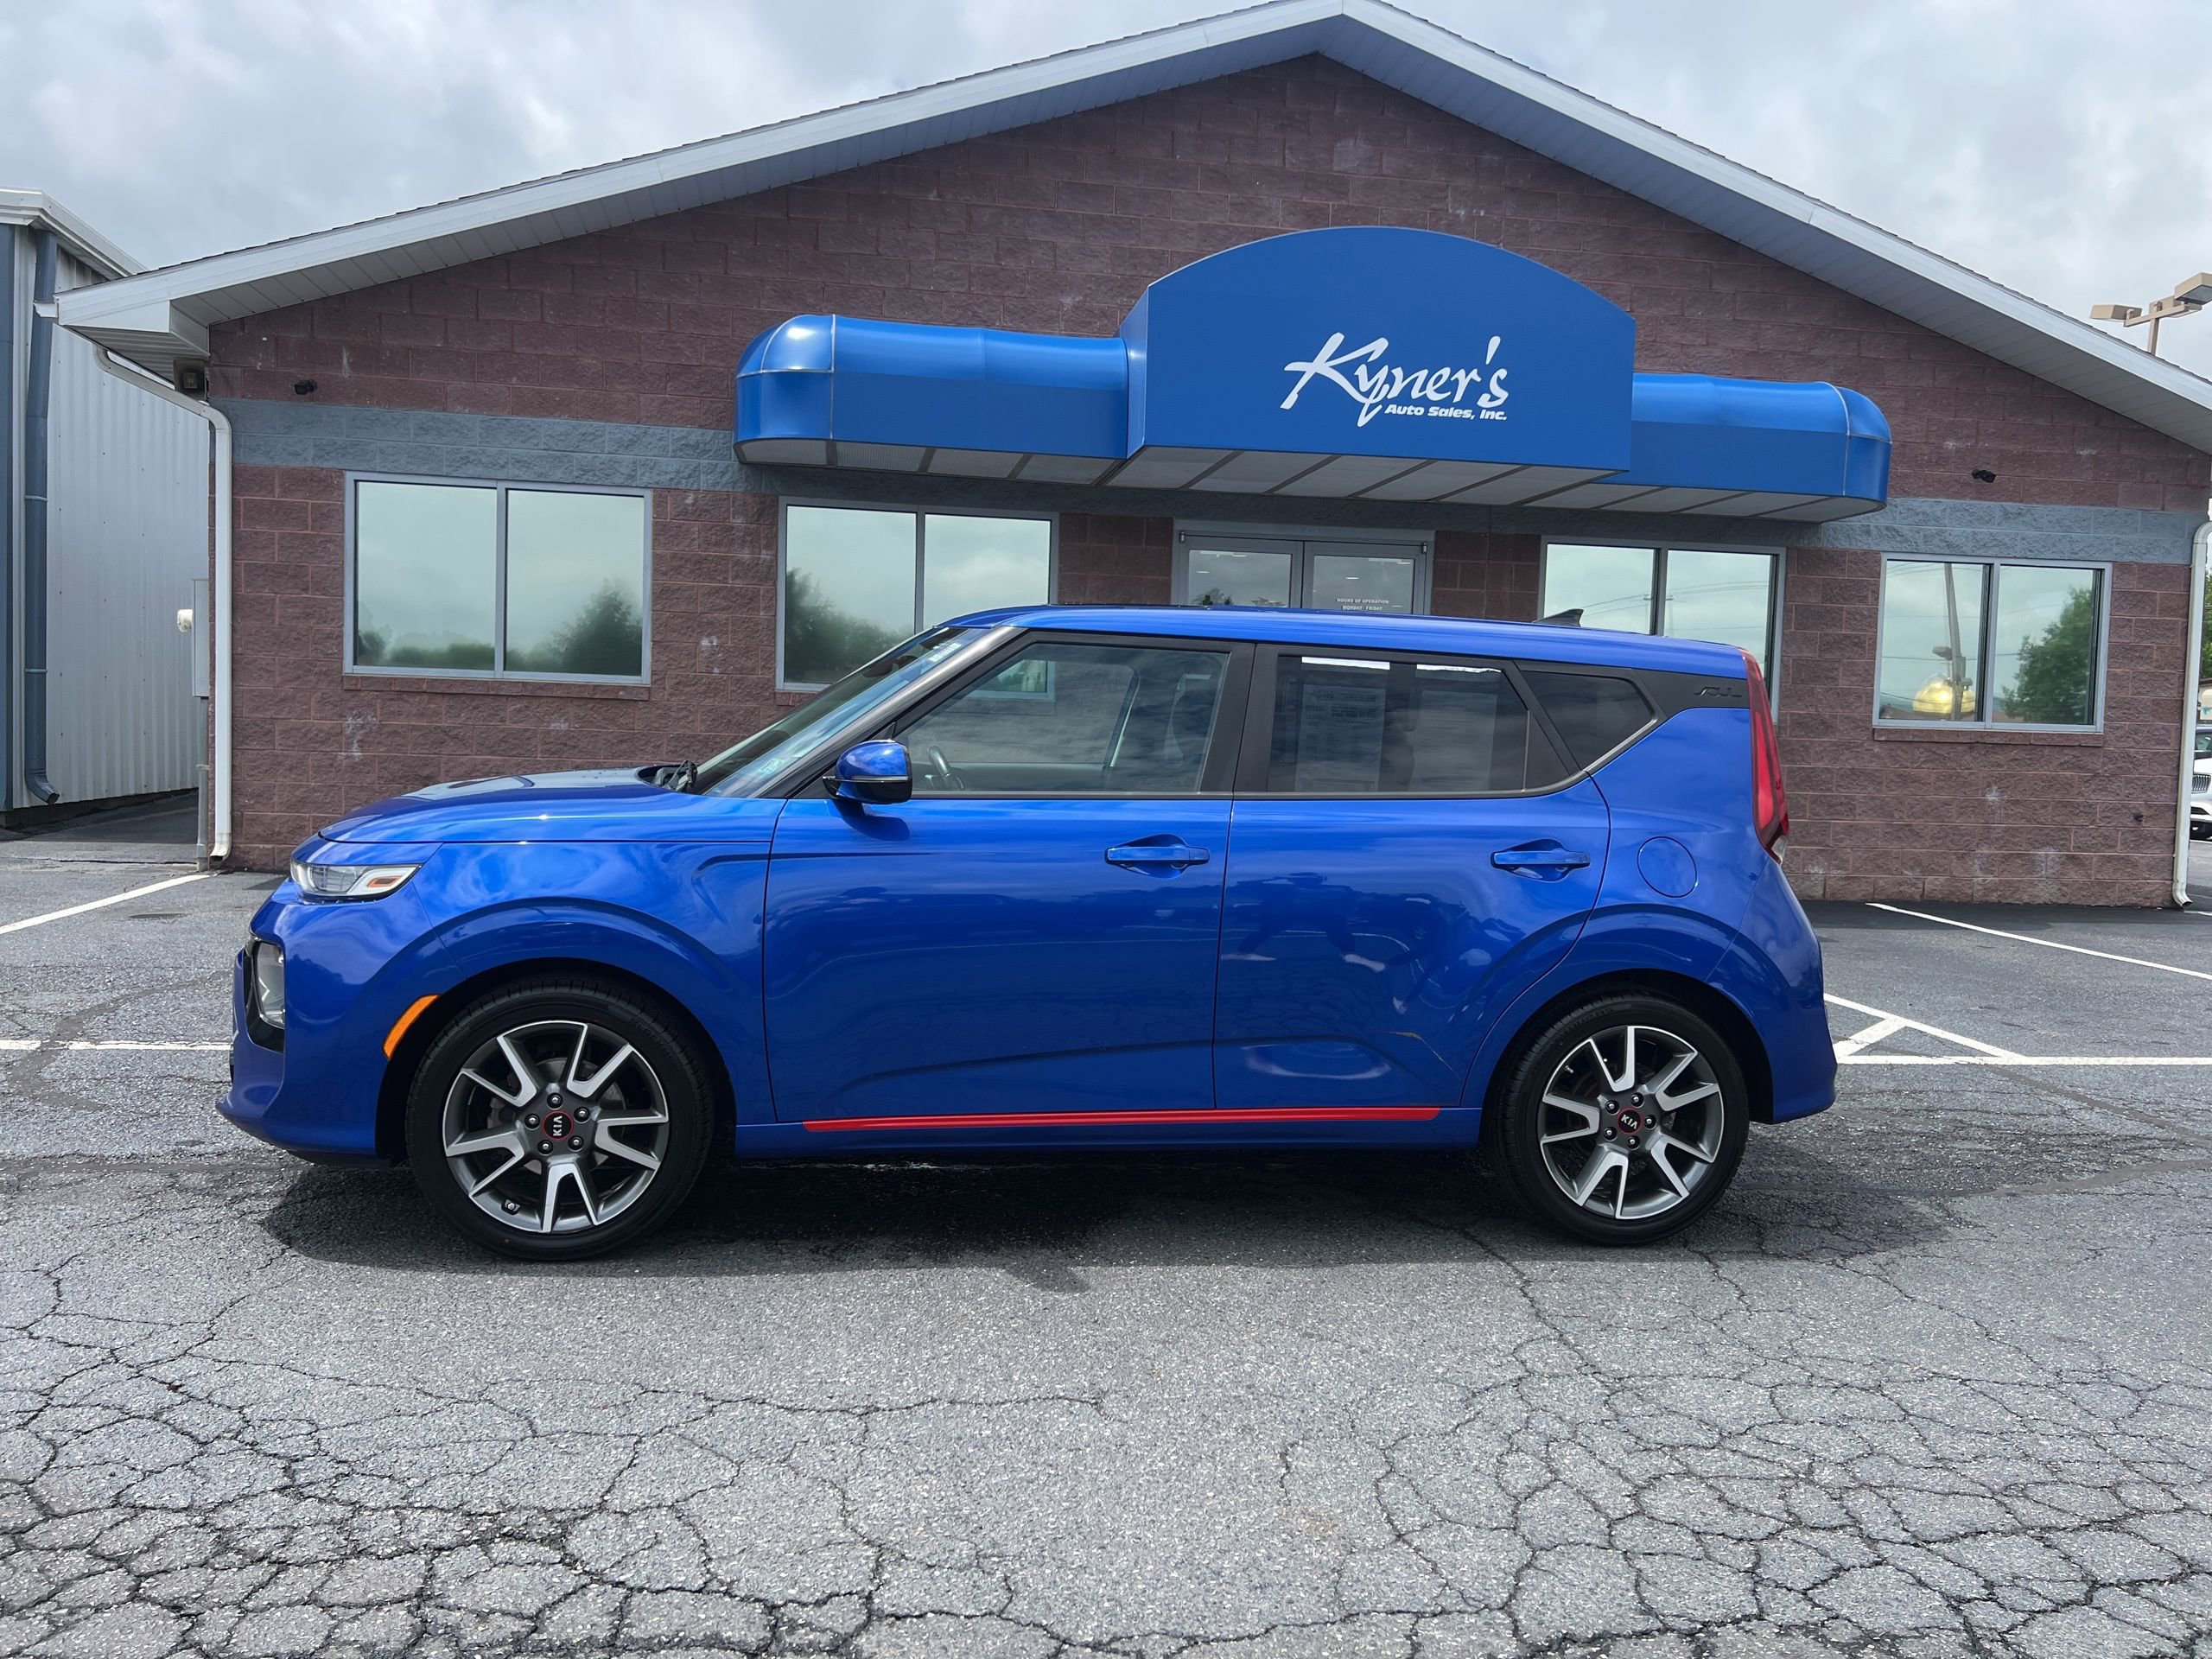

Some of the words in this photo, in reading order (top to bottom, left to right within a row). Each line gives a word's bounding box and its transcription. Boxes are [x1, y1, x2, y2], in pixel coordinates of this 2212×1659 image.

[1280, 332, 1510, 428] Kyner's
[1384, 404, 1425, 416] Auto
[1427, 406, 1476, 420] Sales,
[1479, 409, 1508, 421] Inc.
[553, 1115, 563, 1136] KIA
[1621, 1114, 1638, 1129] KIA
